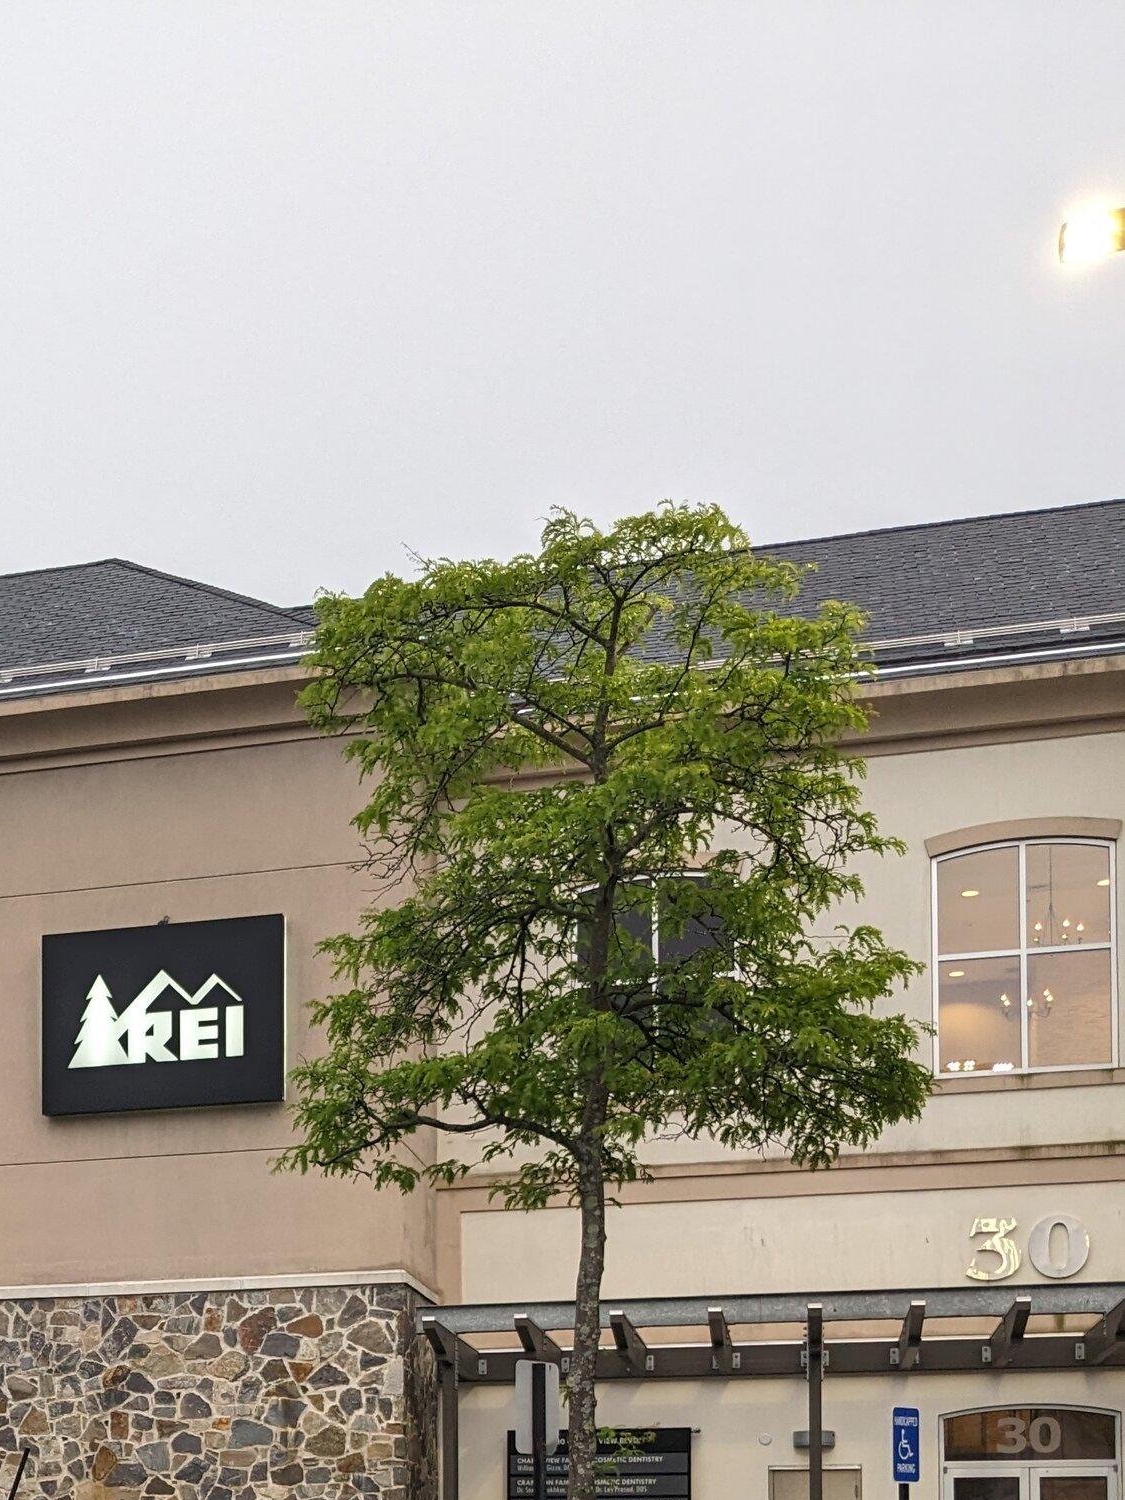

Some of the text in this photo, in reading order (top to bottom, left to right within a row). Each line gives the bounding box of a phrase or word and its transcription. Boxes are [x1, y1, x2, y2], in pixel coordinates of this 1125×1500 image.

[128, 1003, 244, 1064] REI
[965, 1214, 1090, 1281] 30
[996, 1416, 1062, 1454] 30
